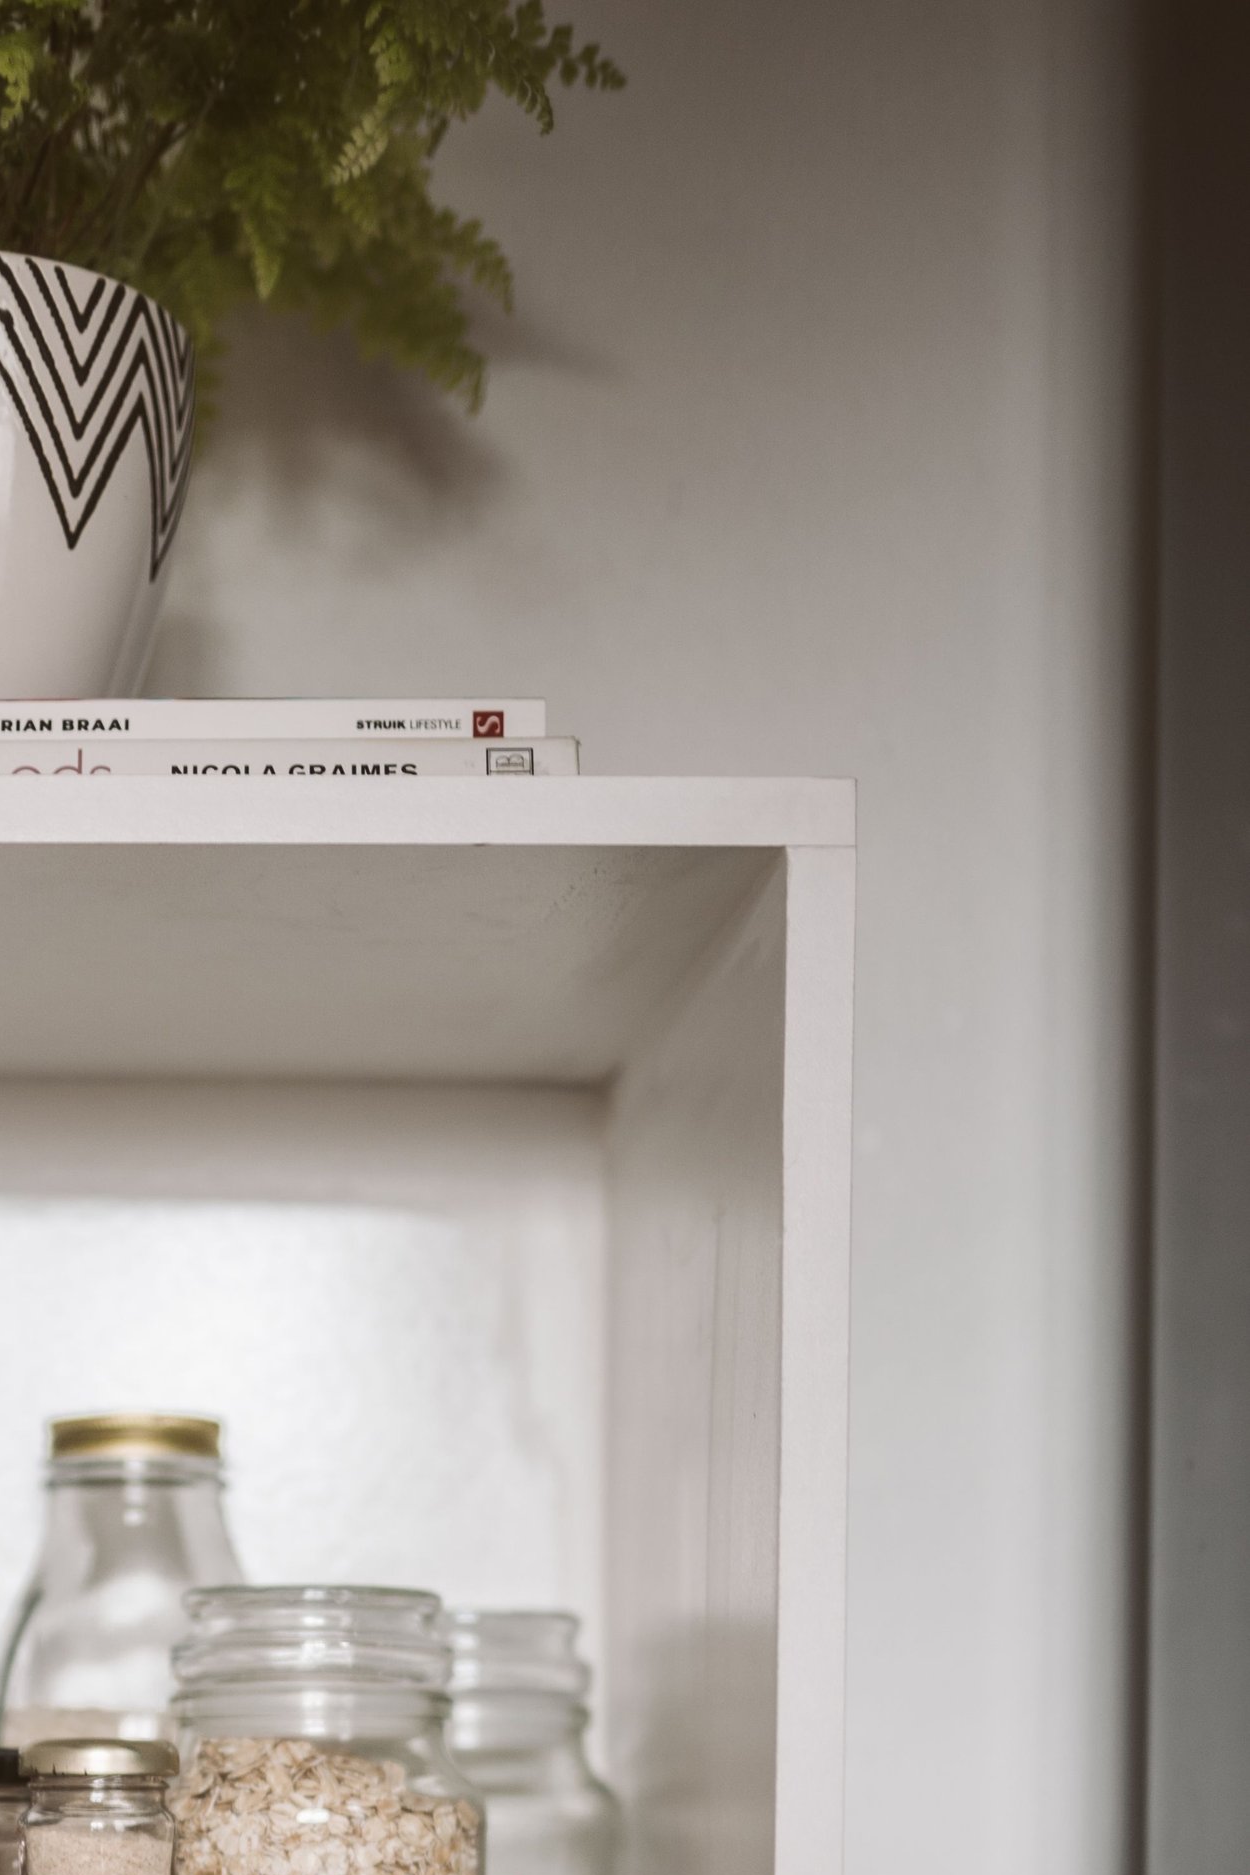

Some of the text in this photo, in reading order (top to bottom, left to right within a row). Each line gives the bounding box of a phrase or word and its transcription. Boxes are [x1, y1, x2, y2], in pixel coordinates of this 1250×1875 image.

[62, 718, 130, 732] BRAAI
[356, 719, 462, 730] STRUIK LIFESTYLE
